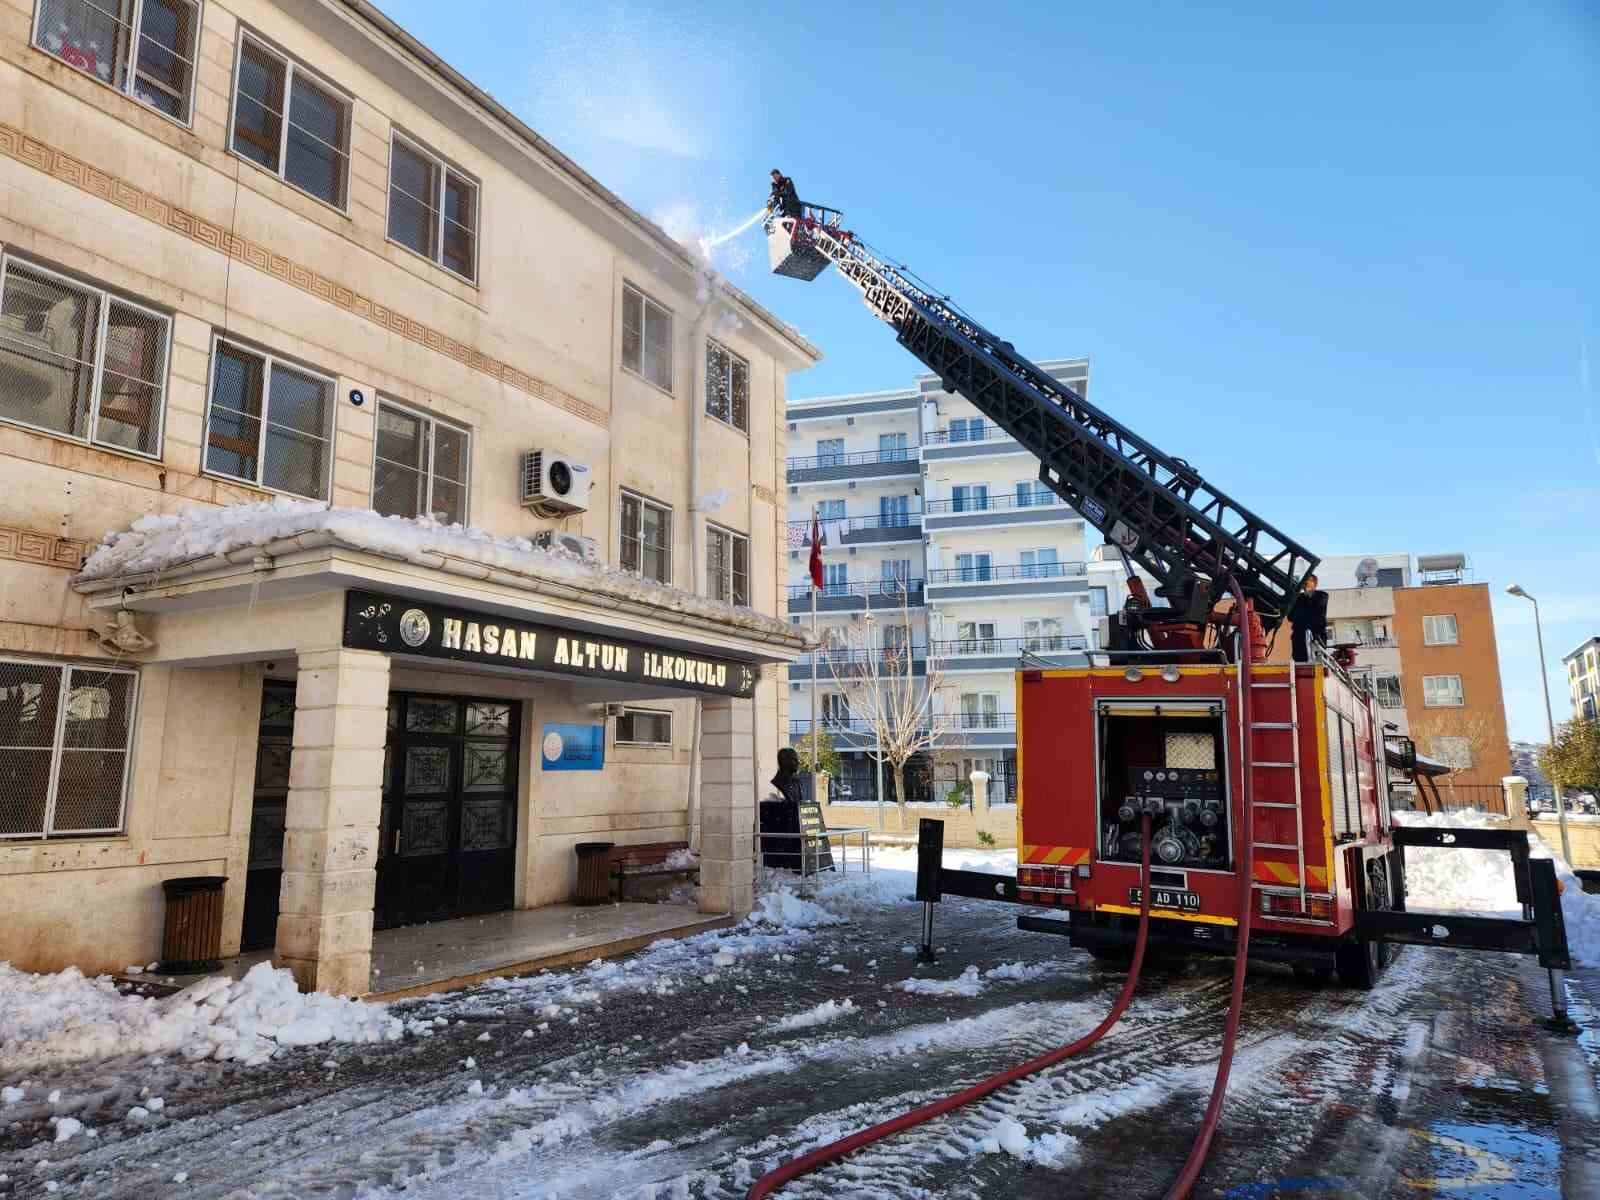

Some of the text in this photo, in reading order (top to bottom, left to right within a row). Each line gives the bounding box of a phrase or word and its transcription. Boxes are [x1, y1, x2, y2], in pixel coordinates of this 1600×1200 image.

[441, 617, 727, 688] HASAN ALTUN İLKOKULU
[1157, 892, 1170, 904] AD
[1177, 894, 1197, 906] 110
